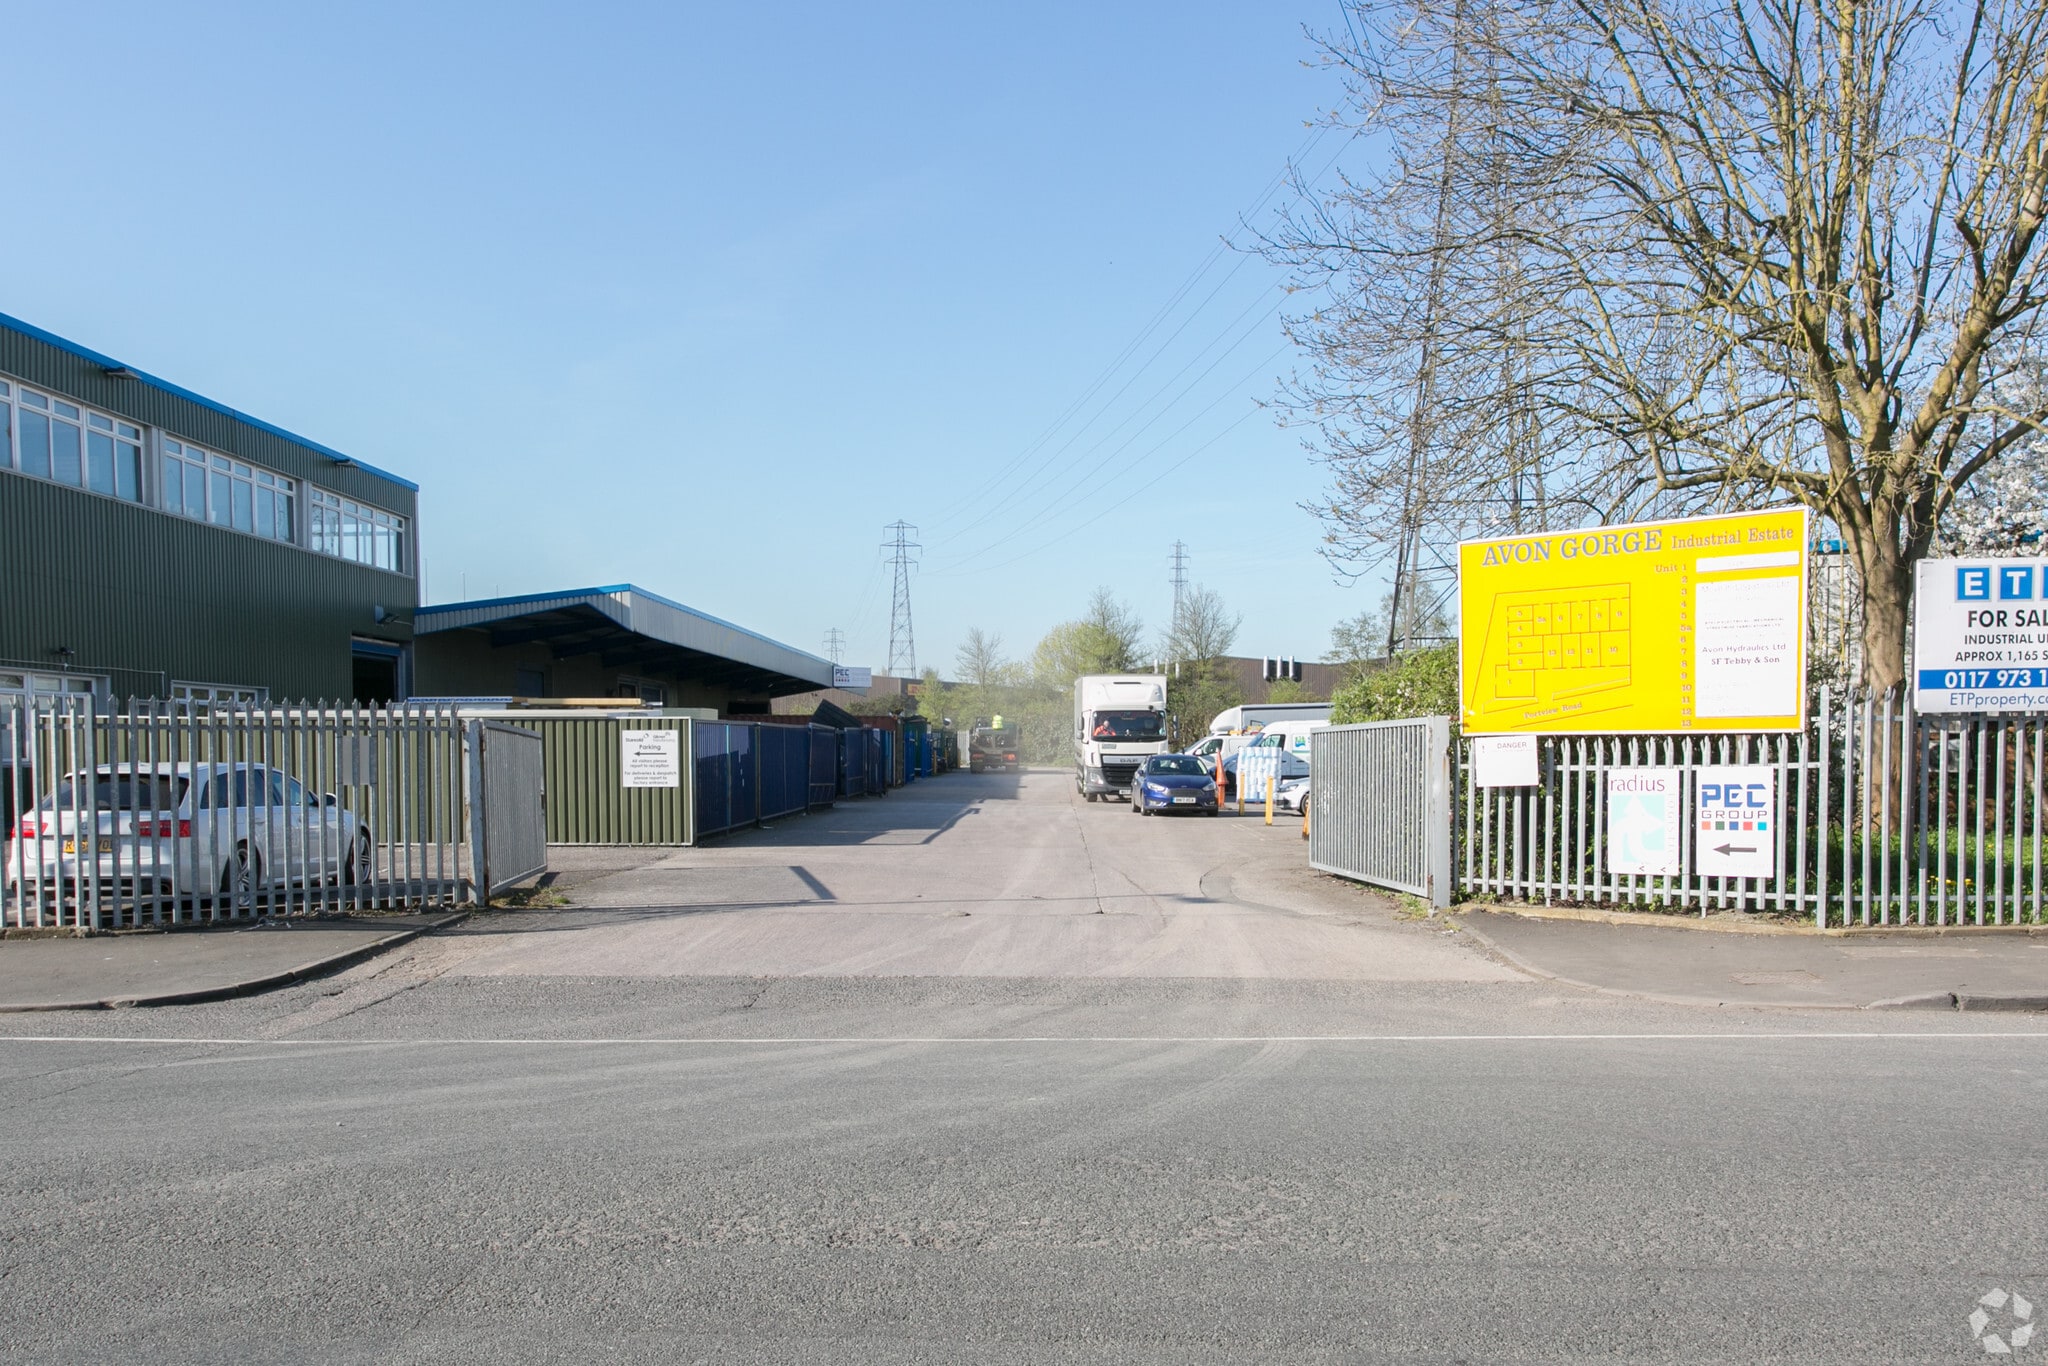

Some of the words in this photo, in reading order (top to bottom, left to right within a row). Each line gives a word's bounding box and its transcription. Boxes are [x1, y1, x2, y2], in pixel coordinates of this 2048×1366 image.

[1482, 540, 1552, 566] AVON
[1561, 529, 1663, 559] GORGE
[1672, 529, 1741, 549] Industrial
[1748, 527, 1794, 542] Estate
[1655, 564, 1678, 573] Unit
[1681, 575, 1688, 583] 2
[1681, 587, 1688, 595] 3
[1681, 600, 1687, 608] 4
[1681, 612, 1687, 620] 5
[1968, 610, 2008, 627] FOR
[1964, 634, 2033, 645] INDUSTRIAL
[1681, 648, 1687, 656] 7
[1726, 644, 1769, 653] Hydraulics
[1772, 643, 1786, 651] Ltd
[1711, 657, 1721, 666] SF
[1722, 657, 1752, 666] Tebby
[1753, 656, 1761, 664] &
[1764, 655, 1780, 663] Son
[1955, 651, 2003, 662] APPROX
[2007, 650, 2038, 663] 1,165
[1681, 660, 1688, 668] 8
[835, 668, 850, 676] PEC
[1681, 672, 1688, 680] 9
[1944, 671, 1990, 689] 0117
[1996, 669, 2032, 687] 973
[1682, 684, 1692, 692] 10
[1523, 706, 1558, 719] Portview
[1562, 701, 1583, 712] Road
[1681, 719, 1692, 727] 13
[1496, 741, 1528, 749] DANGER
[1610, 773, 1666, 792] radius
[1701, 783, 1767, 808] PEC
[1701, 810, 1768, 819] GROUP
